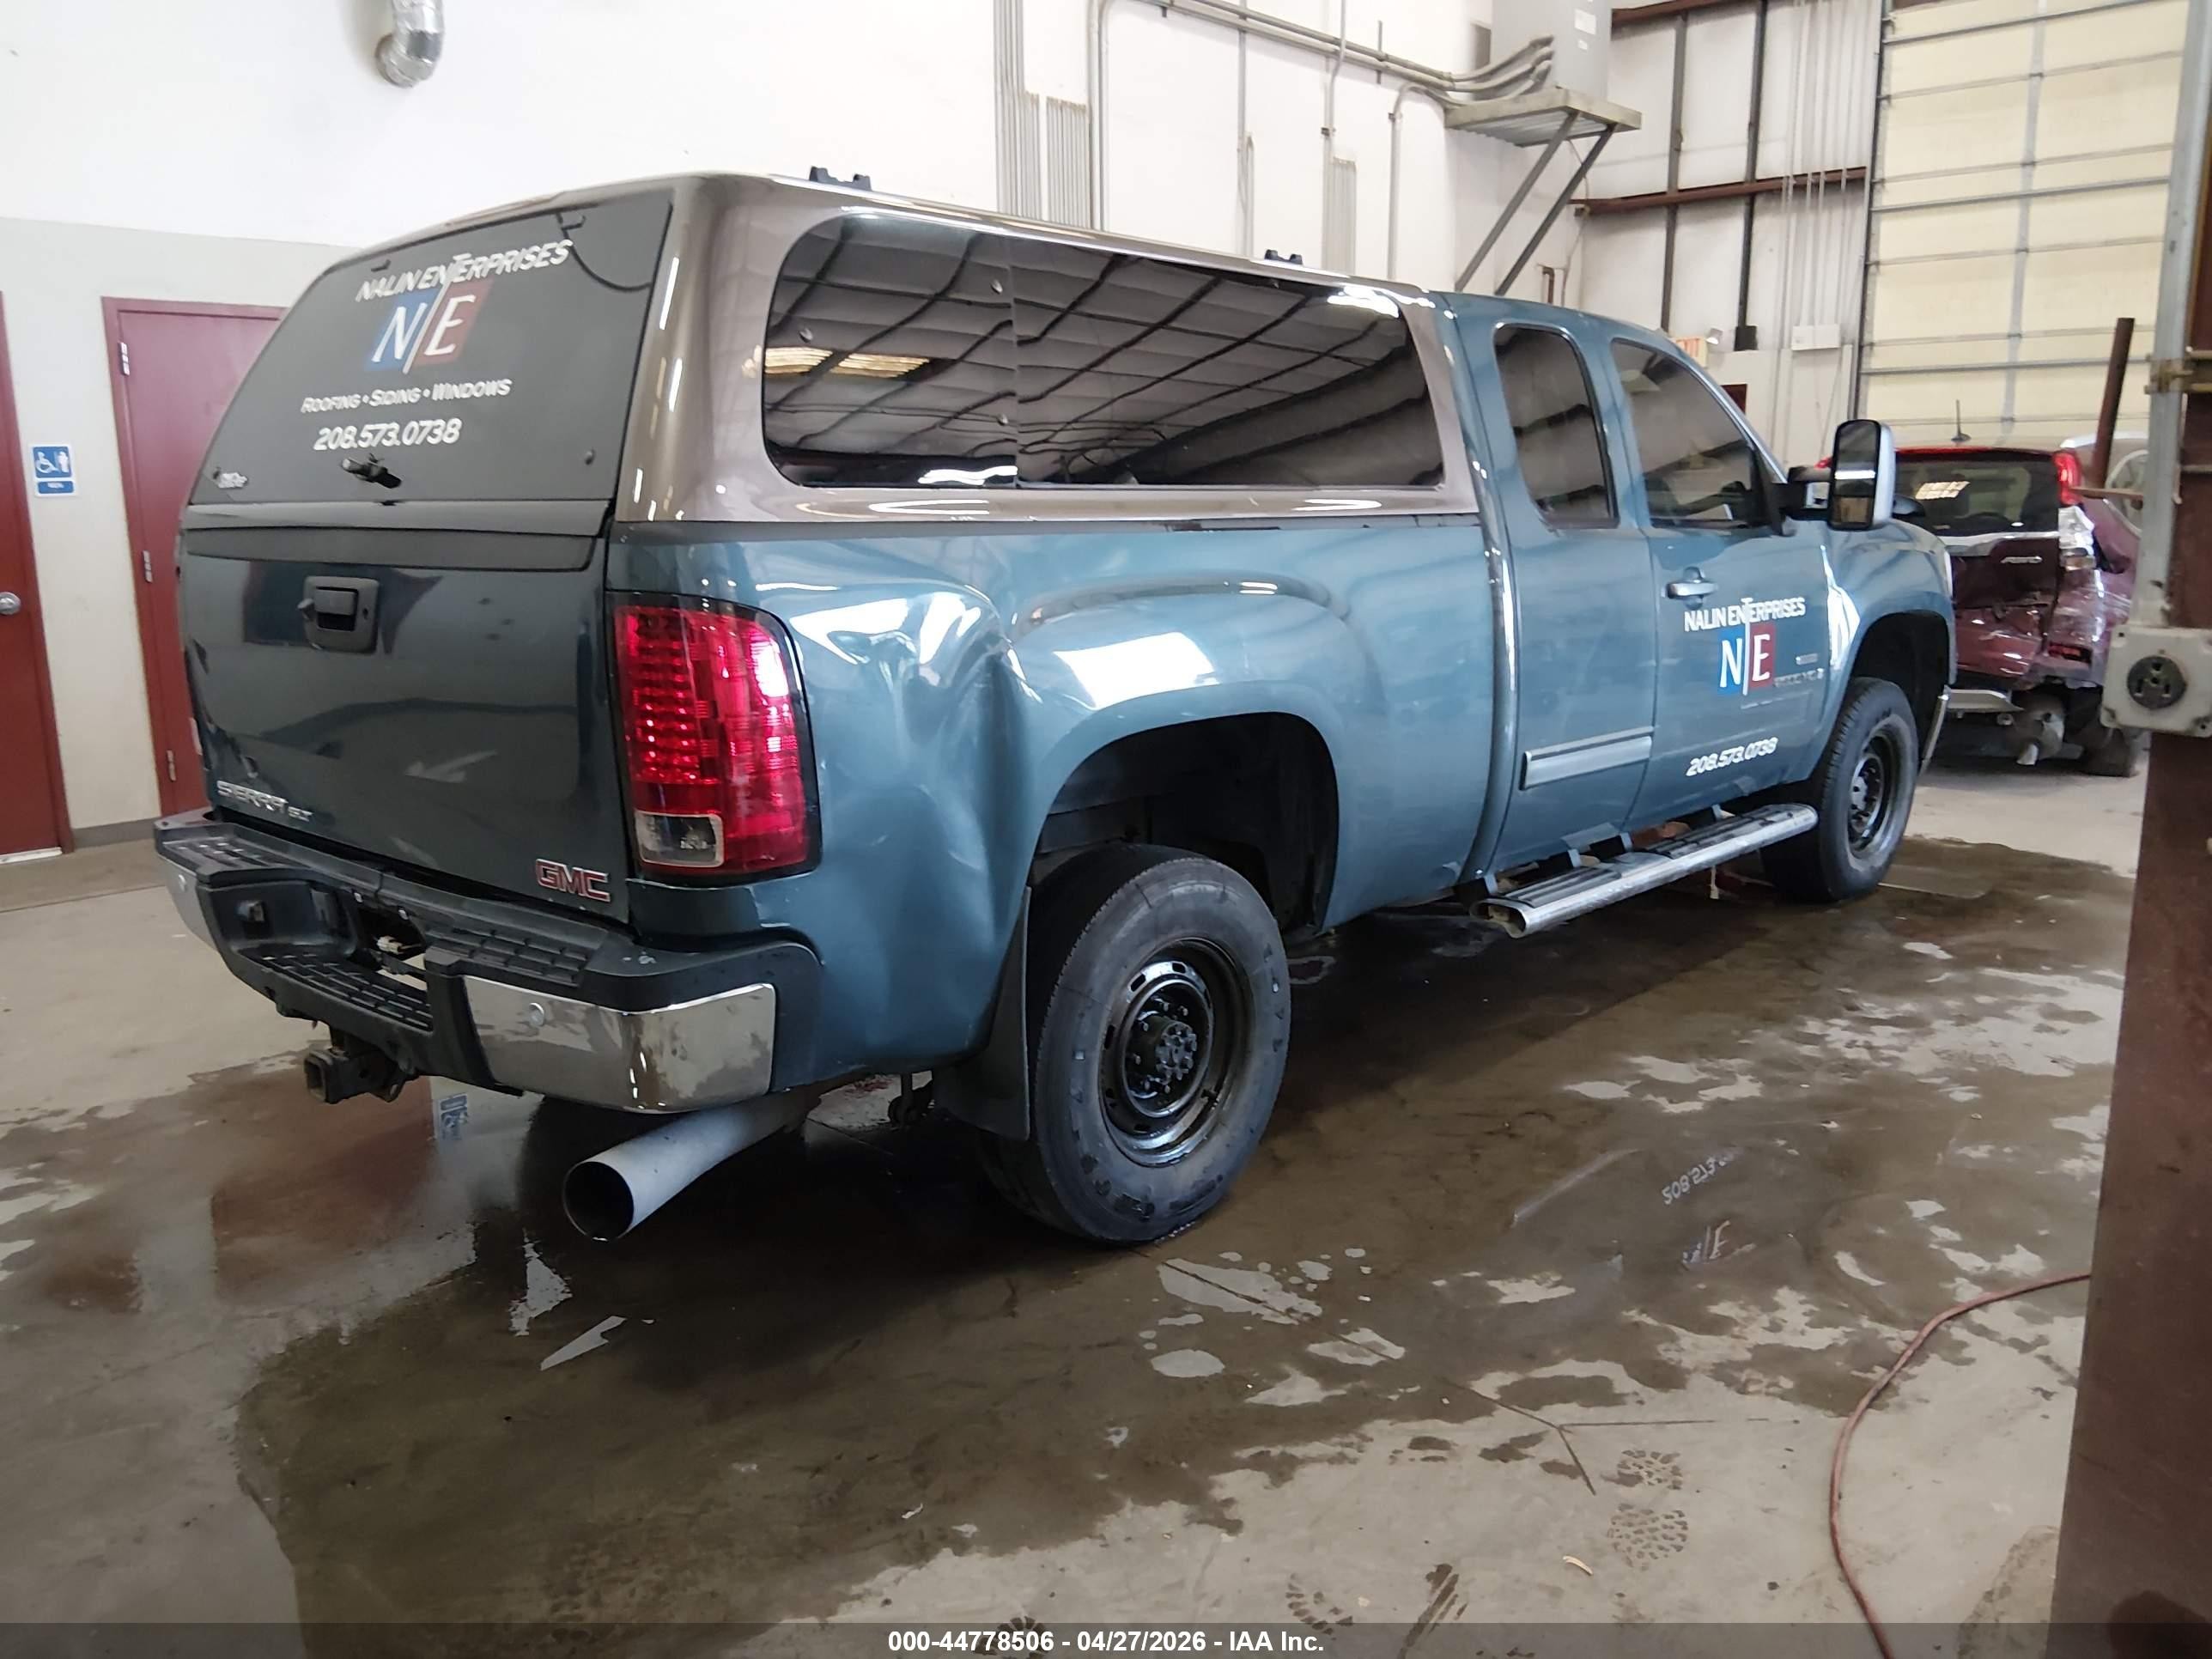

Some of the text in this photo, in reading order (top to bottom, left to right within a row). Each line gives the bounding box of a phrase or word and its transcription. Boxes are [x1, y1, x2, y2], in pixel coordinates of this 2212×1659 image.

[356, 239, 574, 302] NALIN ENTERPRISES
[301, 379, 513, 413] ROOFING SIDING WINDOWS
[313, 417, 463, 450] 208.573.0738
[1684, 597, 1806, 631] NALIN ENTERPRISES
[536, 859, 611, 902] GMC
